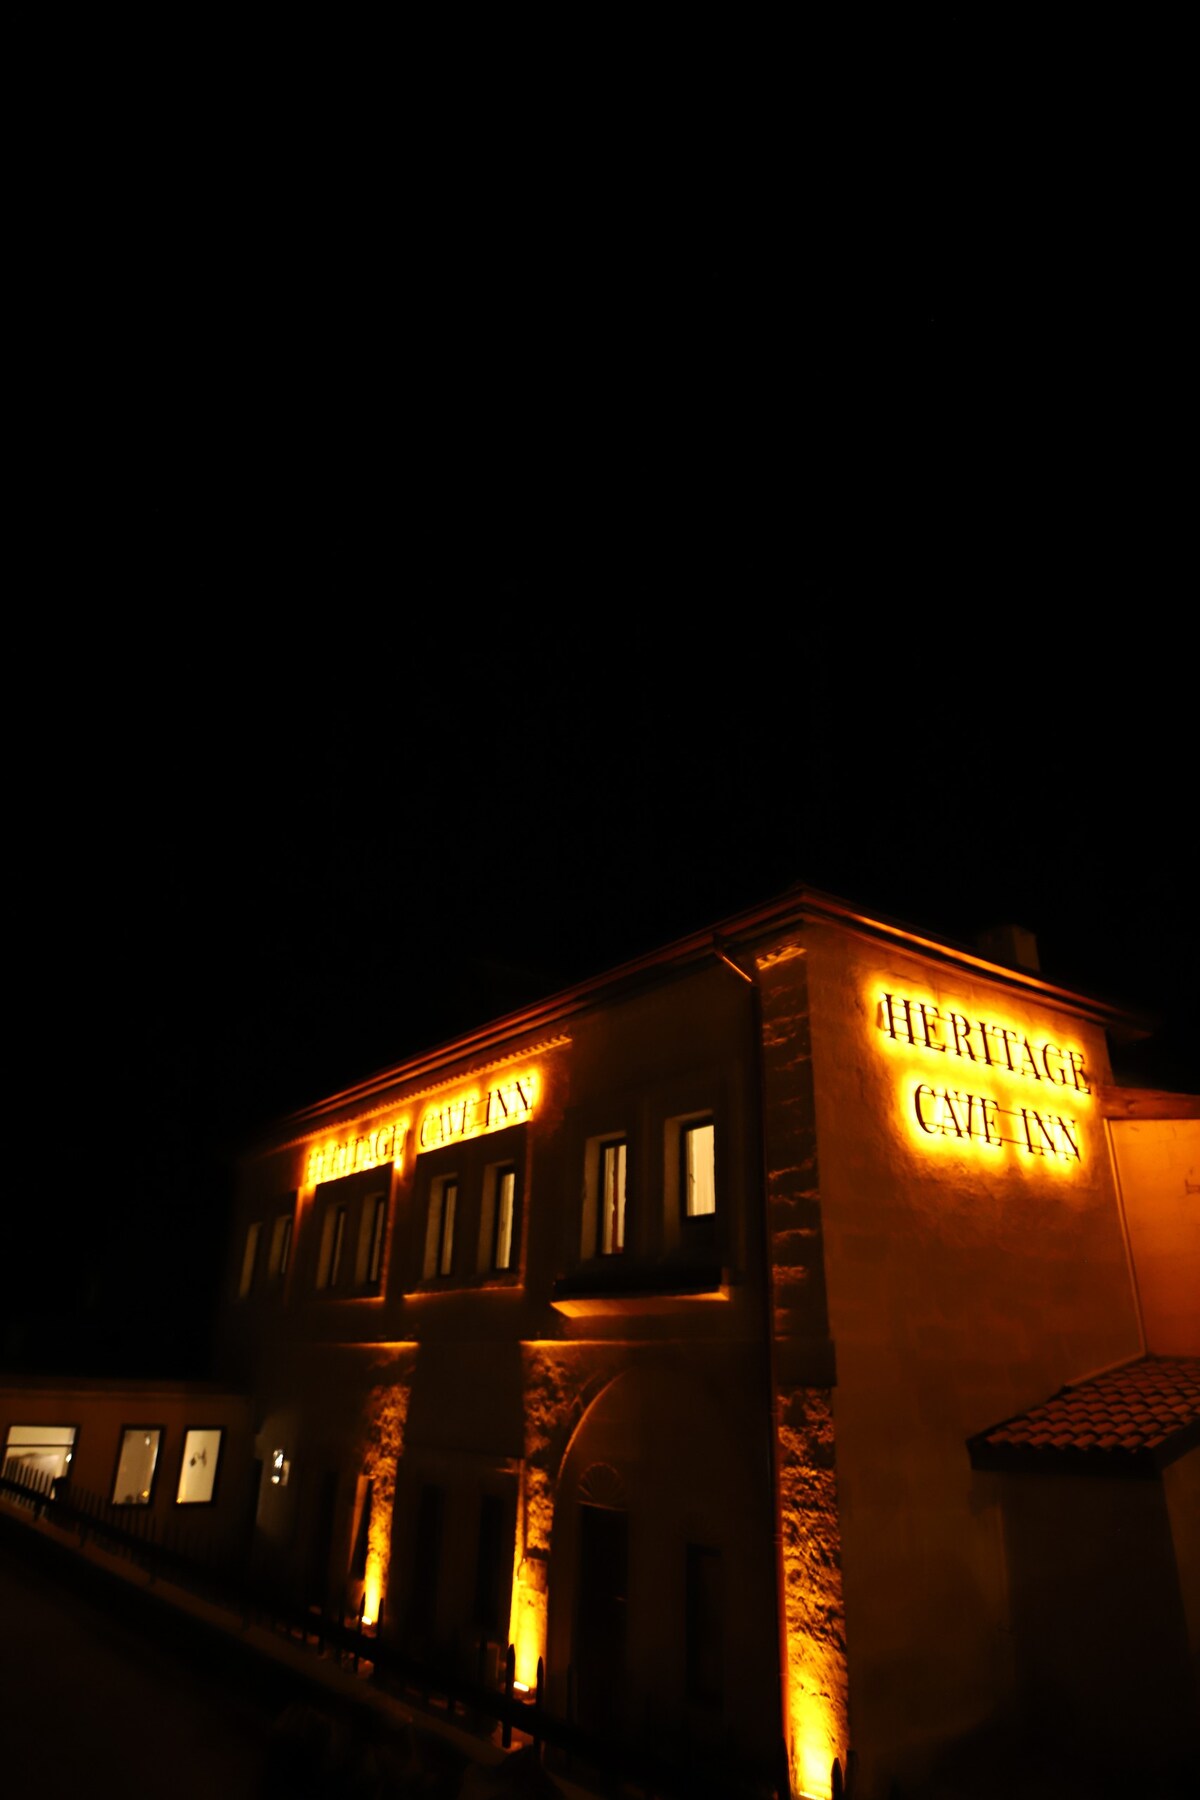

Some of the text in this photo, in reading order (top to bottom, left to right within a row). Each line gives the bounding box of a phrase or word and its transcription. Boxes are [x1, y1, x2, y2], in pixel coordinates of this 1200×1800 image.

[881, 993, 1091, 1094] HERITAGE
[485, 1077, 533, 1127] INN
[914, 1083, 1081, 1162] CAVE INN
